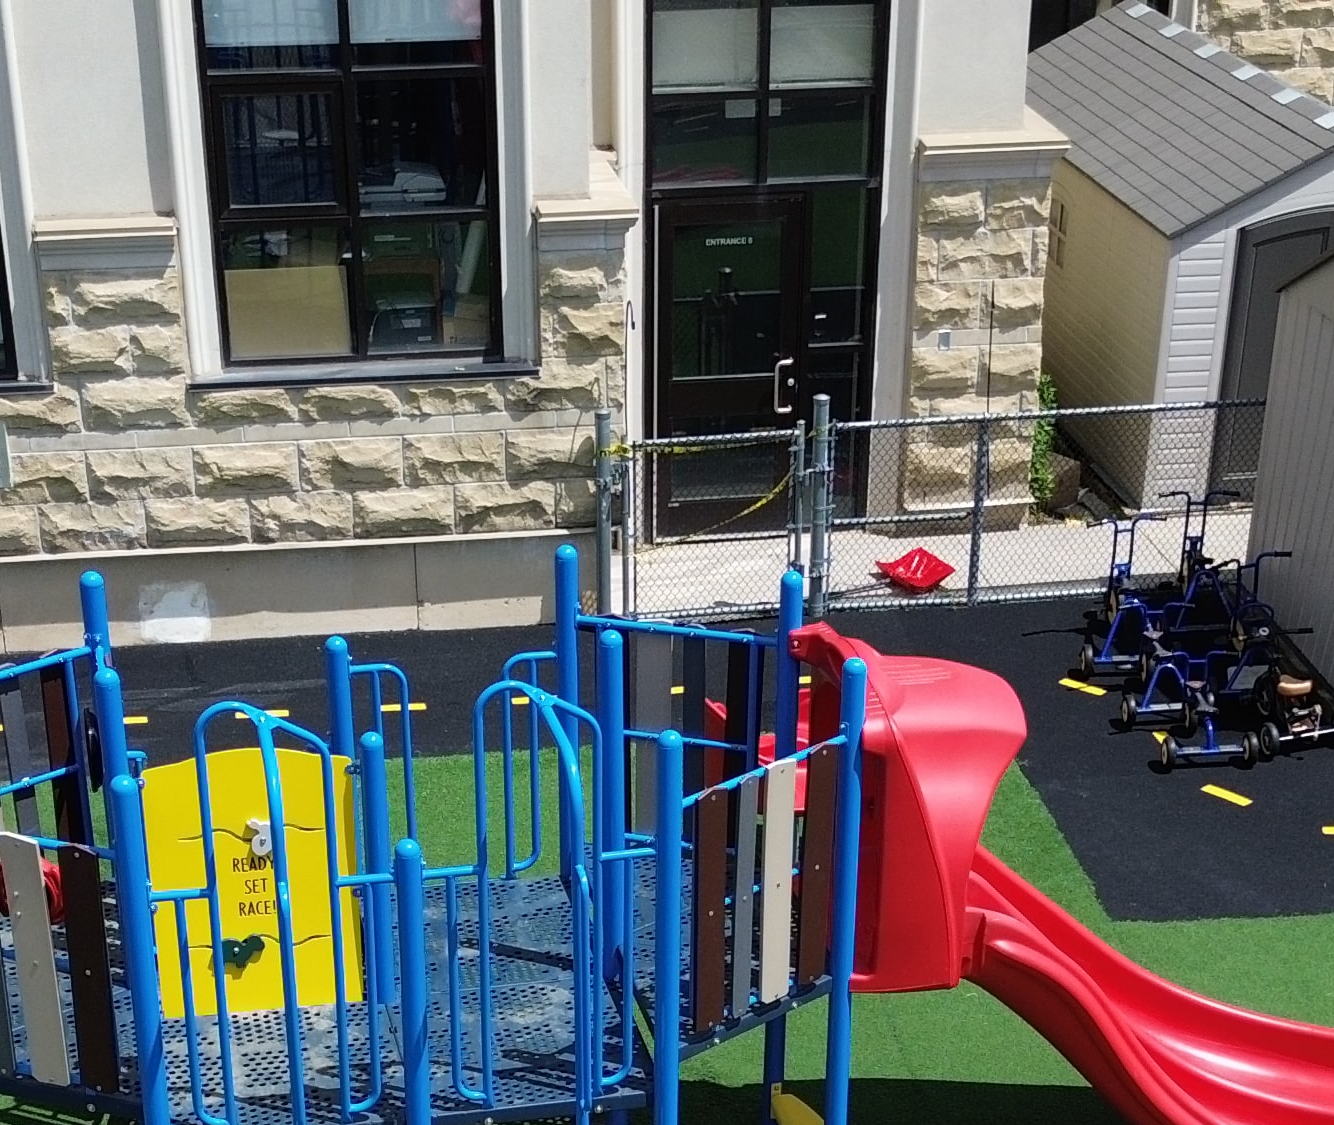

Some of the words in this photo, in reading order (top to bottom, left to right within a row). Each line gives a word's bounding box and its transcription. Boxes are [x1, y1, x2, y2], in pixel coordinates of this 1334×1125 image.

[706, 236, 746, 246] ENTRANCE
[232, 856, 274, 872] READY
[244, 878, 268, 895] SET
[238, 900, 277, 917] RACE!
